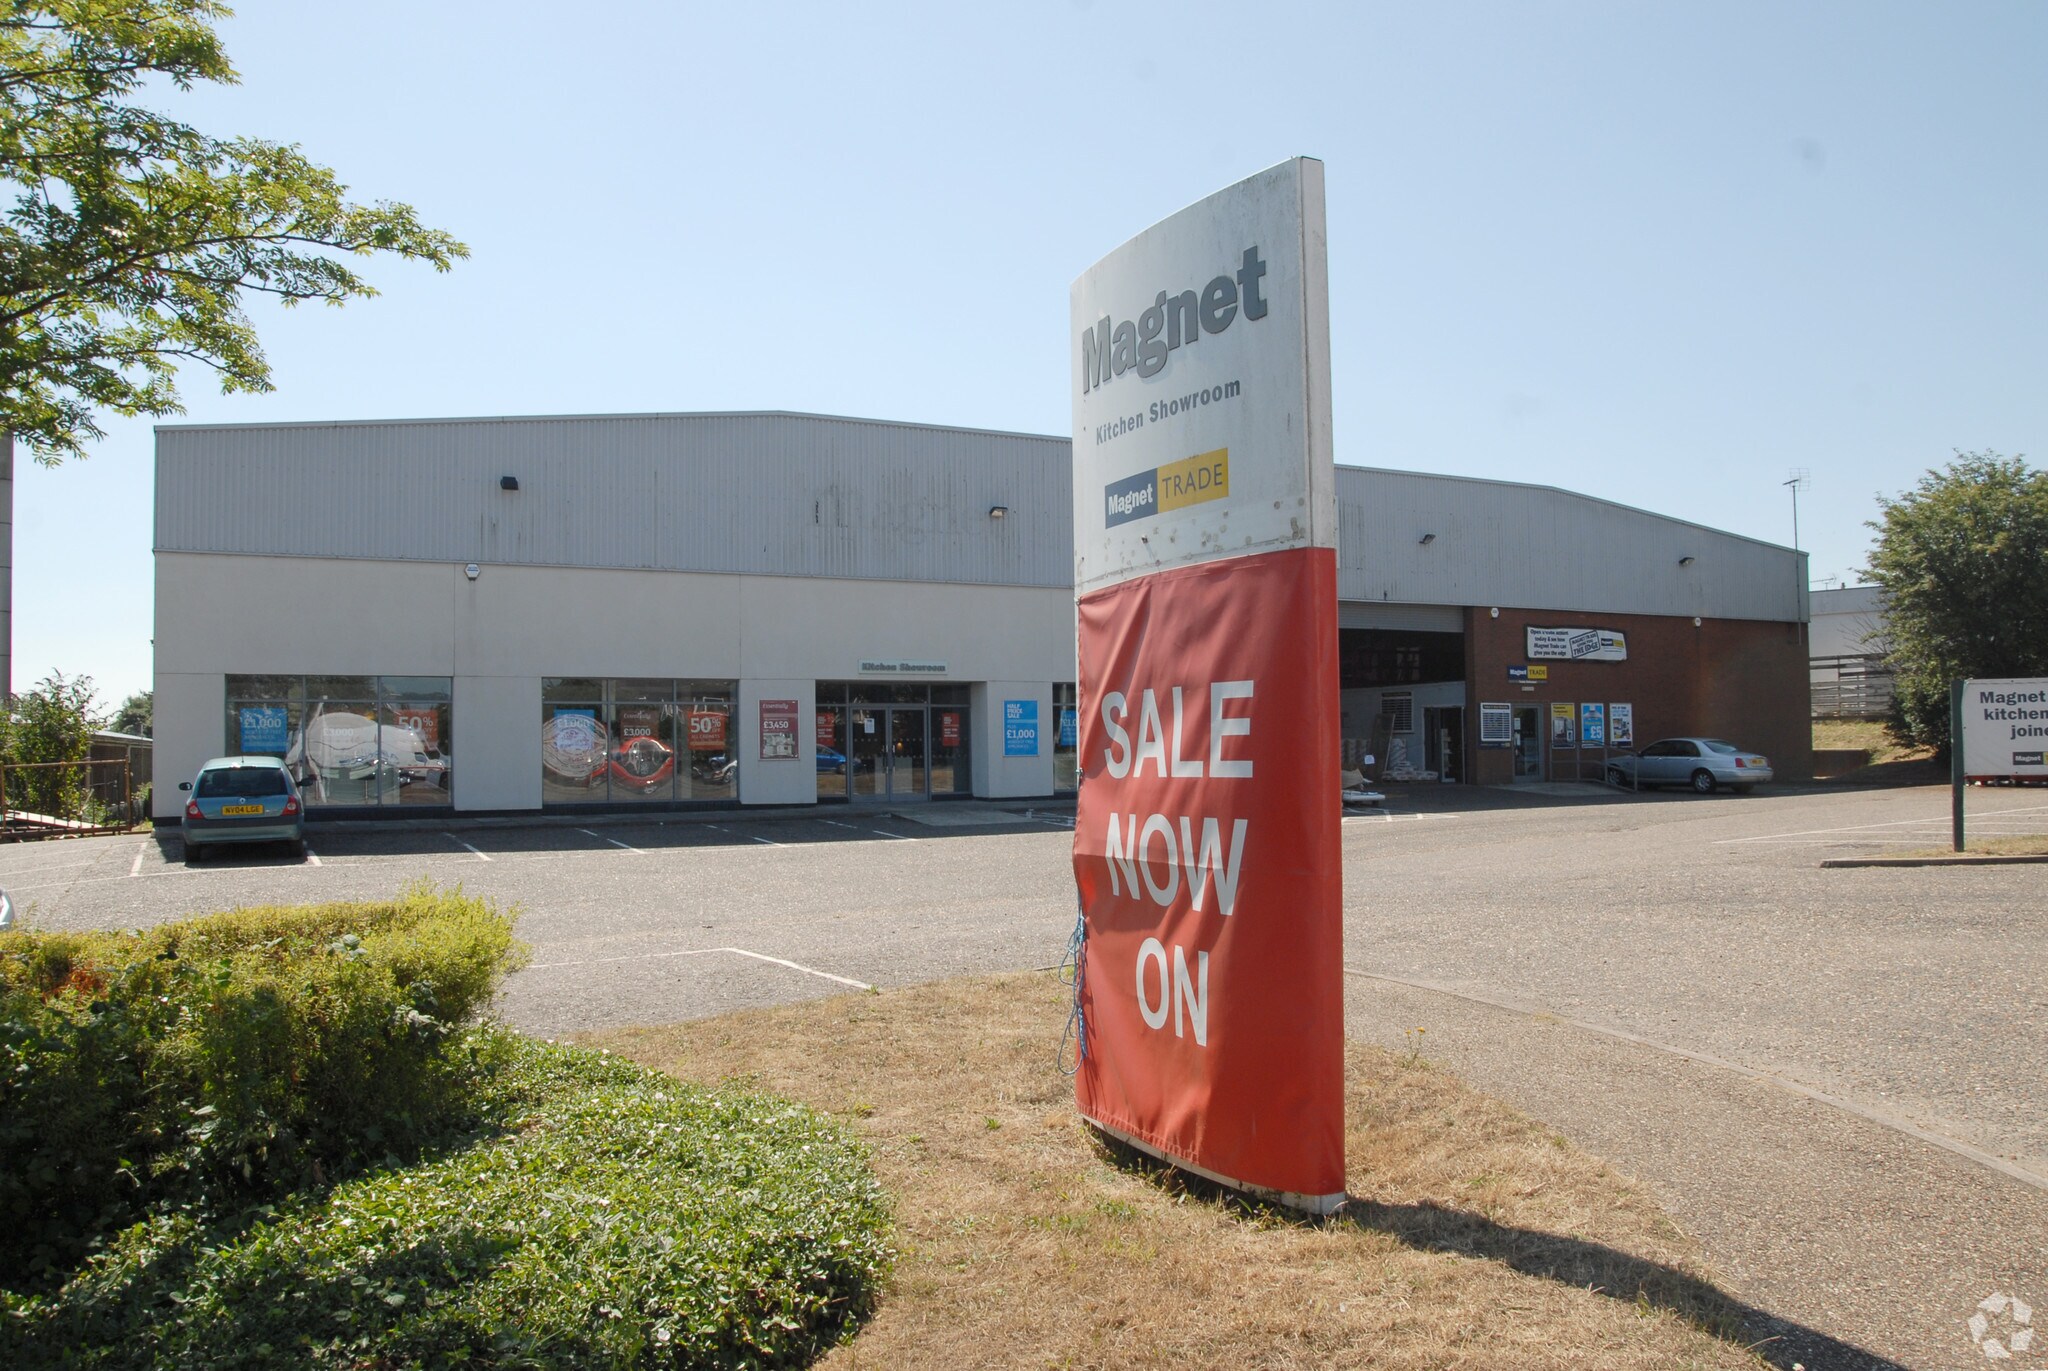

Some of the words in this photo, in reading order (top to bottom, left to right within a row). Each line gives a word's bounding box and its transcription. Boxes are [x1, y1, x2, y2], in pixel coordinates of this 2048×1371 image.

[1082, 245, 1268, 395] Magnet
[1096, 412, 1144, 446] Kitchen
[1149, 376, 1241, 425] Showroom
[1108, 483, 1153, 517] Magnet
[1162, 463, 1223, 500] TRADE
[1574, 647, 1584, 655] THE
[1585, 642, 1598, 651] EDGE
[862, 662, 896, 671] Kitchen
[899, 663, 946, 672] Showroom
[1980, 690, 2046, 706] Magnet
[244, 718, 282, 730] £1,000
[690, 717, 722, 733] 50%
[763, 721, 788, 729] £3,450
[1101, 680, 1254, 779] SALE
[623, 728, 651, 737] £3,000
[1007, 729, 1035, 740] £1,000
[1105, 812, 1248, 916] NOW
[1135, 937, 1209, 1047] ON
